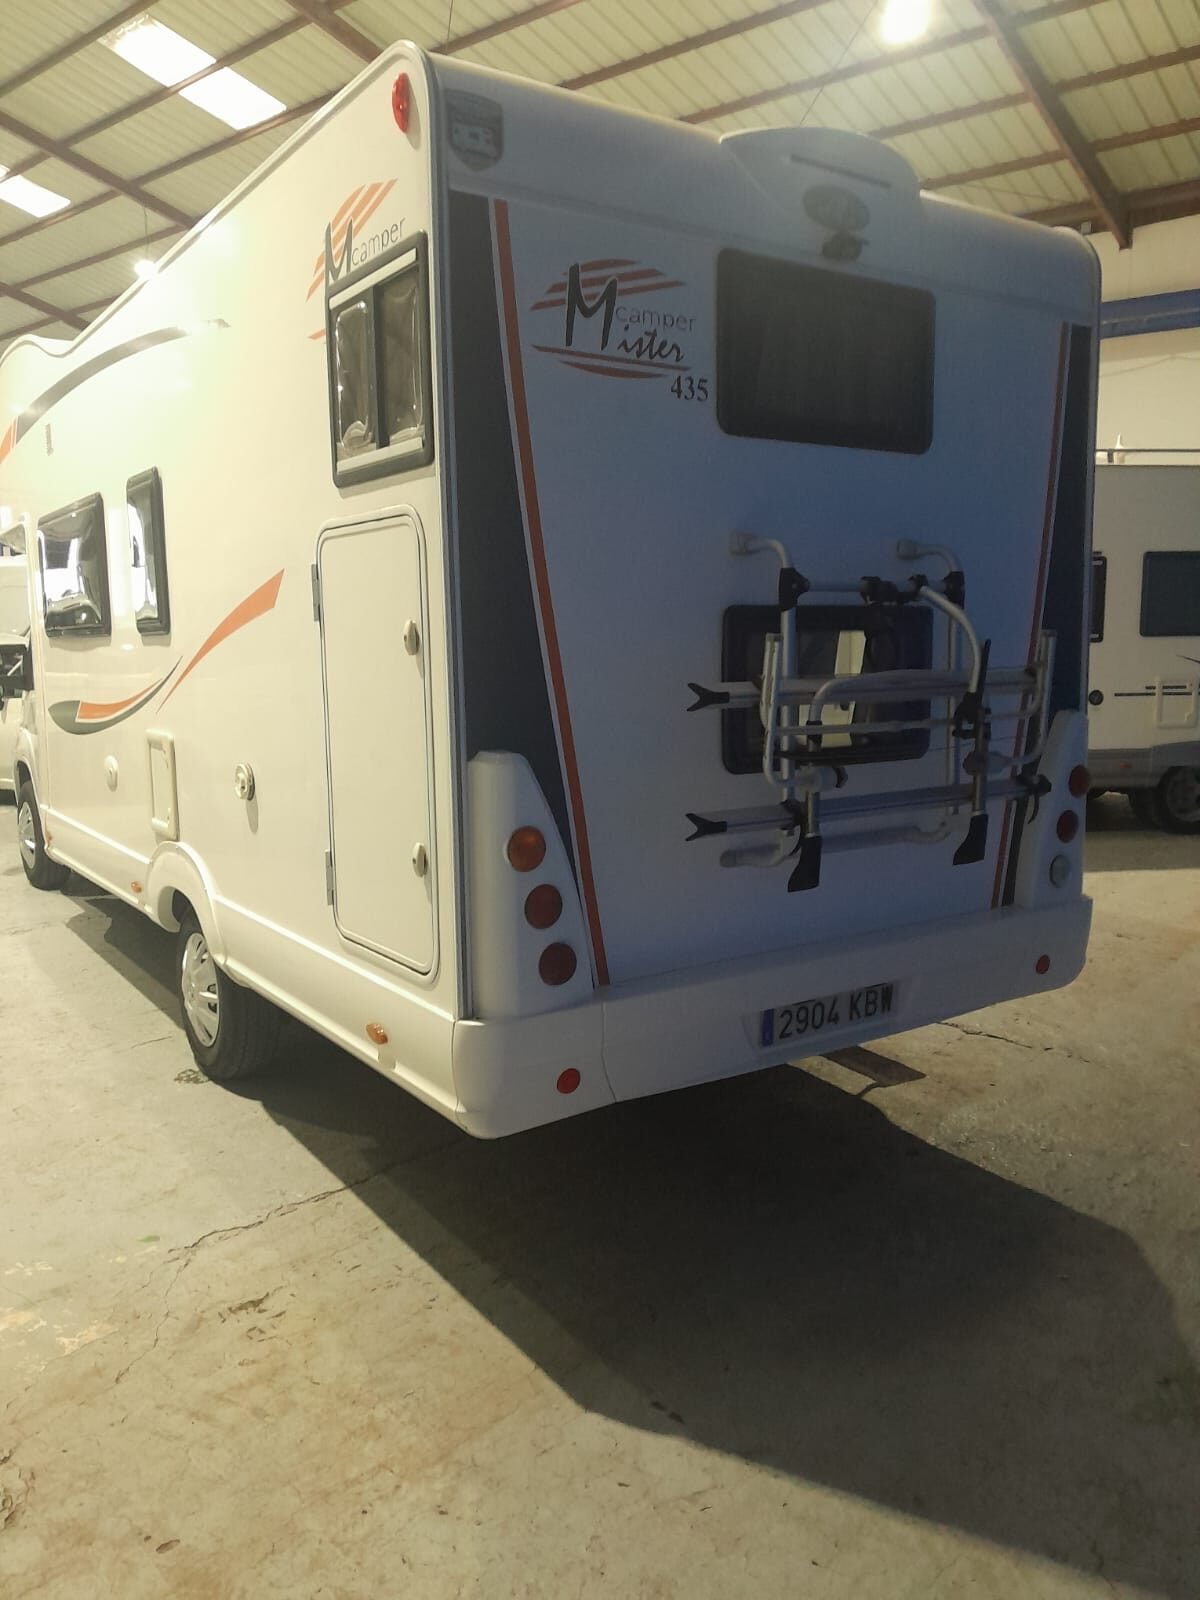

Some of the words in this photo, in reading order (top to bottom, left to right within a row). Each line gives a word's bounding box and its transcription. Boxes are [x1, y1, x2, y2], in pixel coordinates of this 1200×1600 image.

[670, 375, 709, 403] 435
[779, 996, 840, 1039] 2904
[849, 983, 894, 1021] KBW
